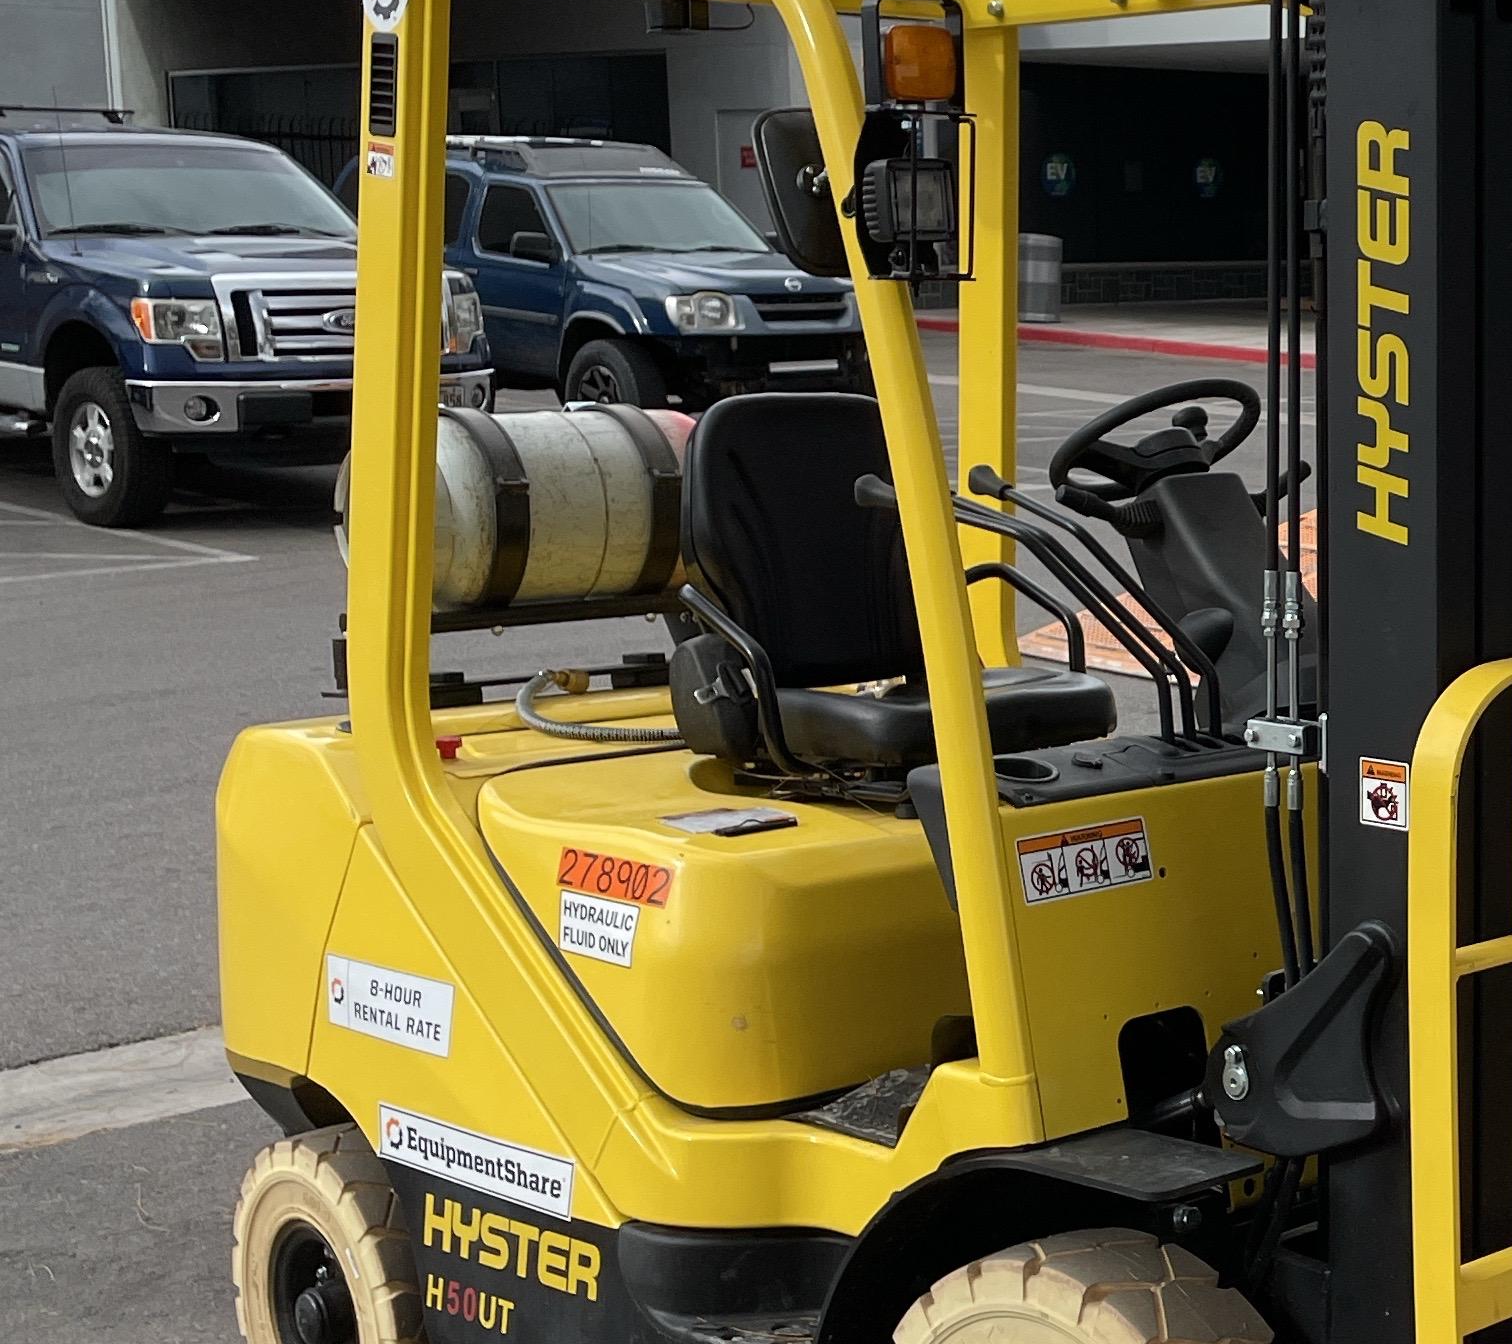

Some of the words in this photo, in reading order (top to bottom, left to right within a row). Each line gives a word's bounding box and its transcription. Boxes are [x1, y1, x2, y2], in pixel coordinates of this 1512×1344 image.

[1046, 163, 1068, 180] EV
[1195, 166, 1216, 184] EV
[1356, 120, 1410, 545] HYSTER
[558, 849, 671, 905] 278902
[563, 898, 634, 932] HYDRAULIC
[563, 926, 596, 949] FLUID
[599, 936, 629, 958] ONLY
[370, 979, 422, 1008] 8-HOUR
[354, 1001, 401, 1031] RENTAL
[406, 1016, 442, 1042] RATE
[406, 1125, 562, 1199] EquipmentShare
[423, 1192, 601, 1302] HYSTER
[426, 1273, 515, 1335] H50UT
